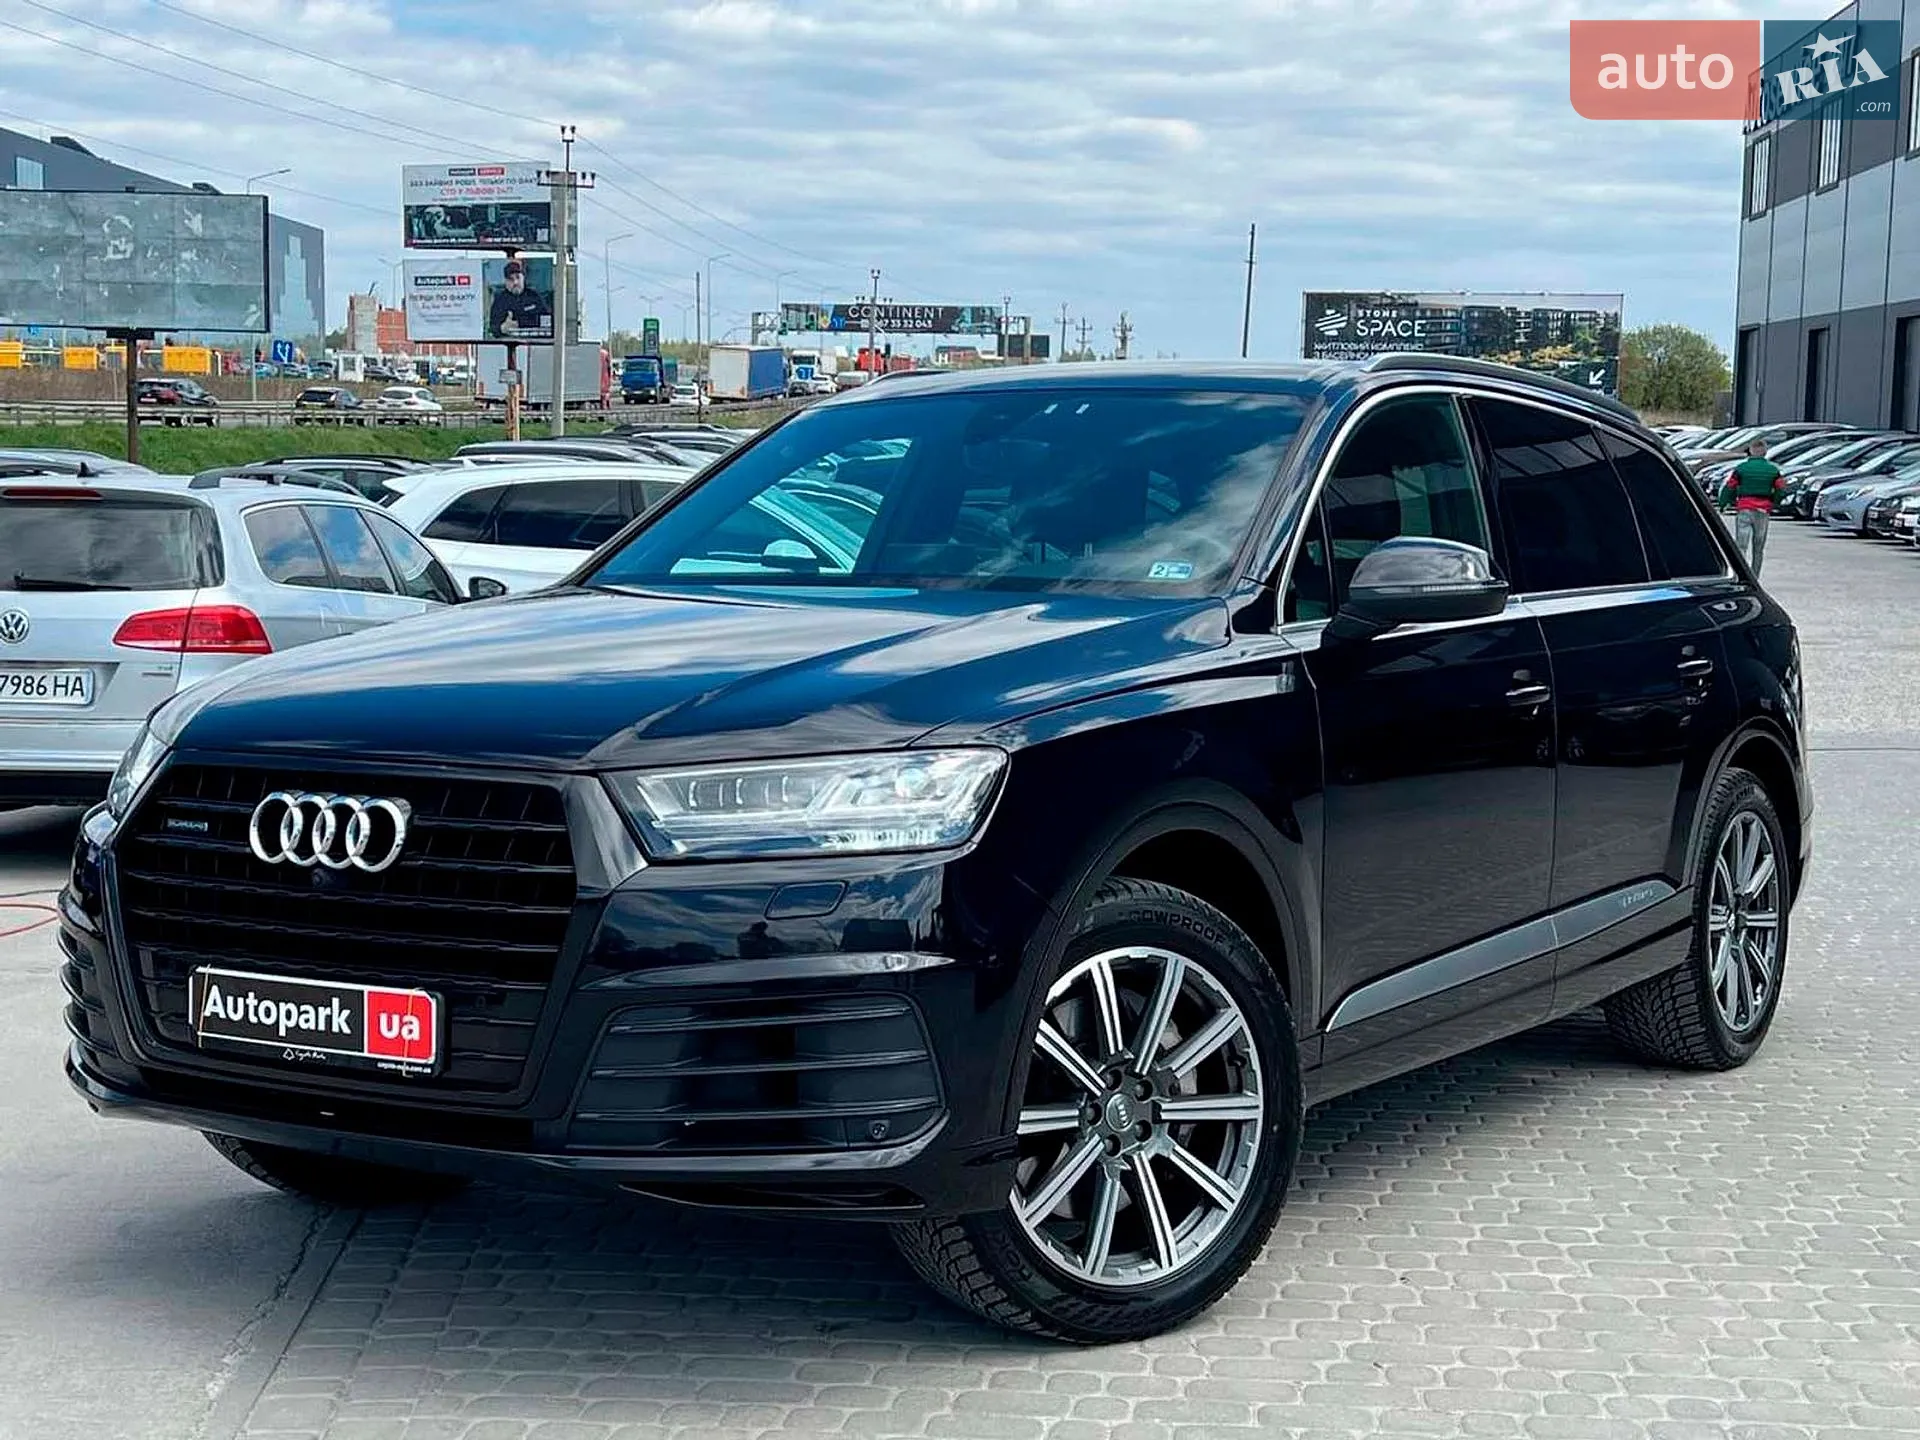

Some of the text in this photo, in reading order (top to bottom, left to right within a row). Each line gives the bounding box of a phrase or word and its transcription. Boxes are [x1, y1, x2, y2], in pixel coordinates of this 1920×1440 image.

[848, 305, 944, 319] CONTINENT
[1357, 308, 1398, 318] STONE
[1356, 319, 1427, 337] SPACE
[53, 675, 85, 697] HA
[204, 984, 421, 1041] Autopark ua
